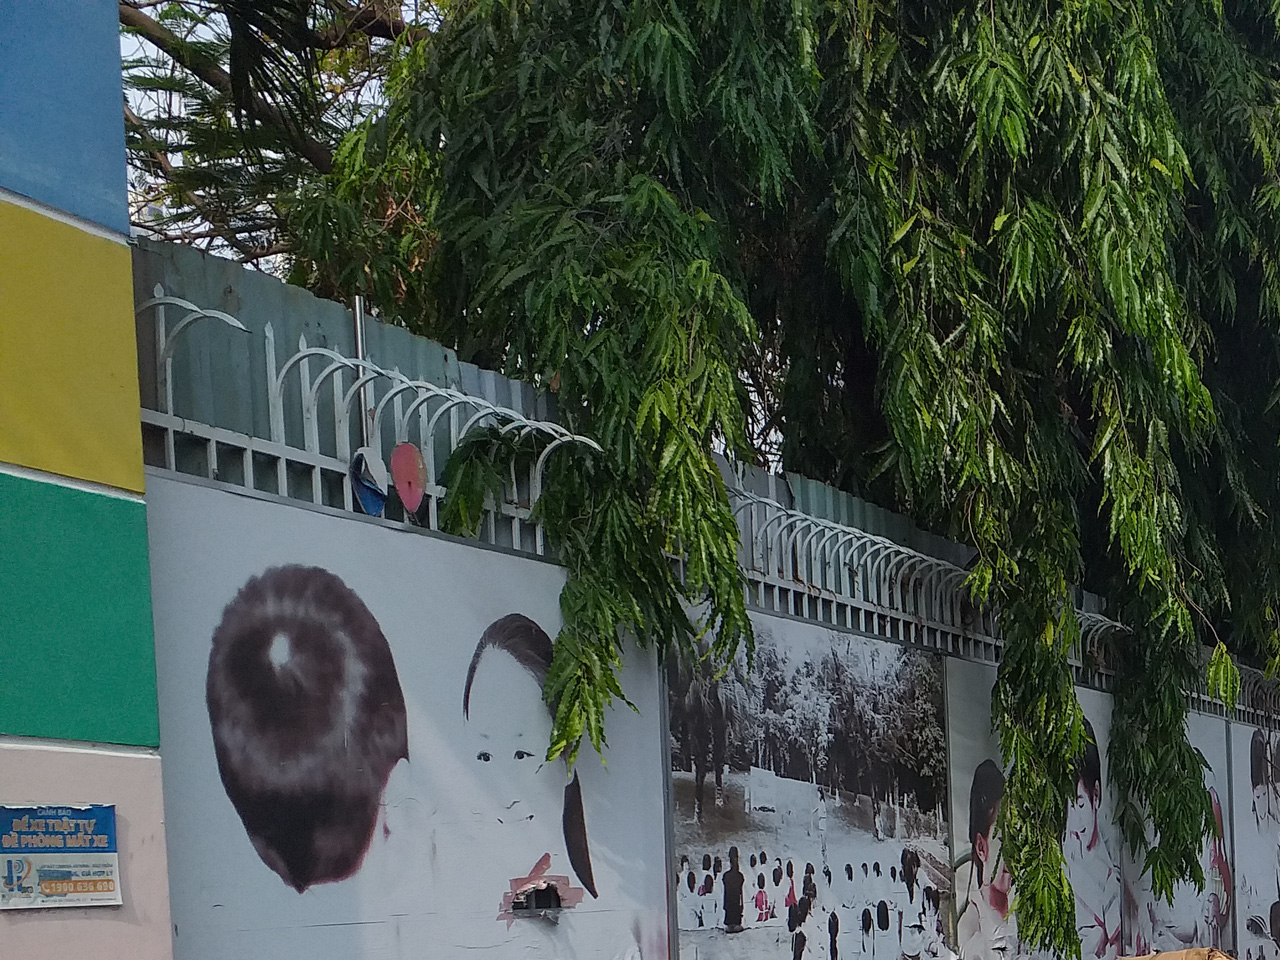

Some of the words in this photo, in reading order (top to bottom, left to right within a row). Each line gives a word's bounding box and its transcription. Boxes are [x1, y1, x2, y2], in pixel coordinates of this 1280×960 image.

[29, 819, 45, 832] XE
[20, 832, 64, 848] PHÒNG
[92, 834, 109, 847] XE
